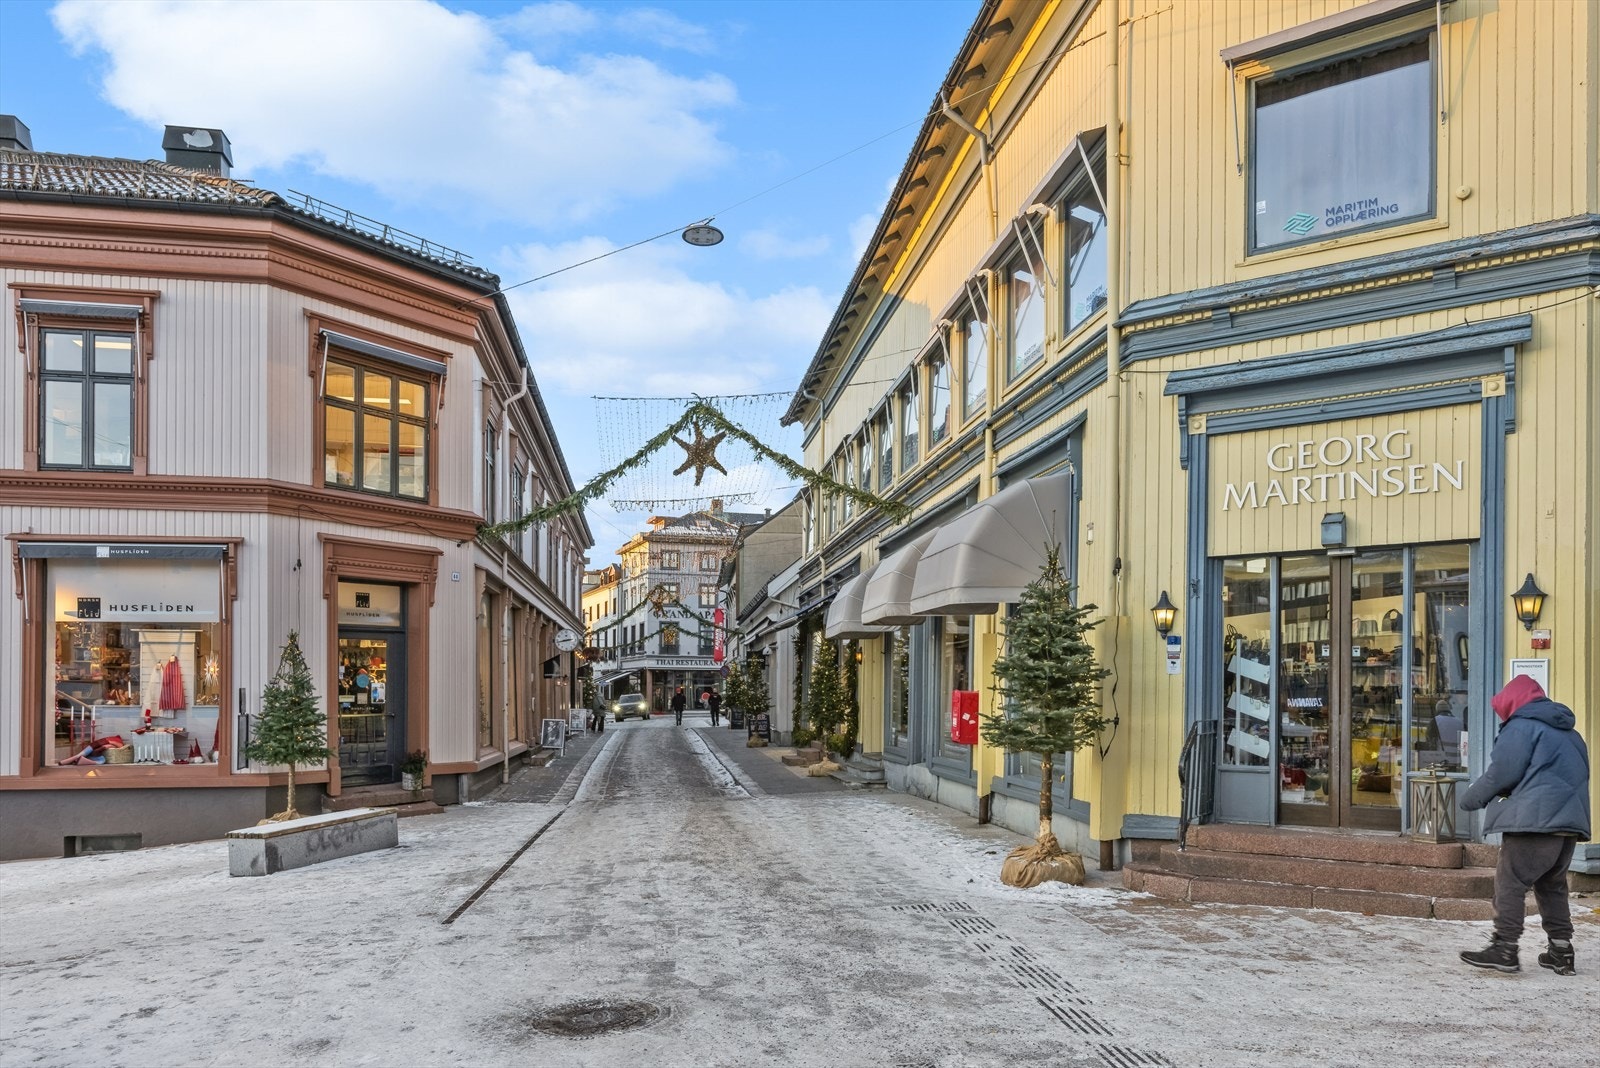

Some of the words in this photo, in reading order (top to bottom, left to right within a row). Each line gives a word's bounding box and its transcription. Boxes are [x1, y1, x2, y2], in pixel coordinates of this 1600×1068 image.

[1325, 197, 1378, 217] MARITIM
[1325, 203, 1399, 228] OPPLÆRING
[1266, 429, 1413, 473] GEORG
[1222, 459, 1465, 512] MARTINSEN
[676, 659, 723, 667] RESTAURANT
